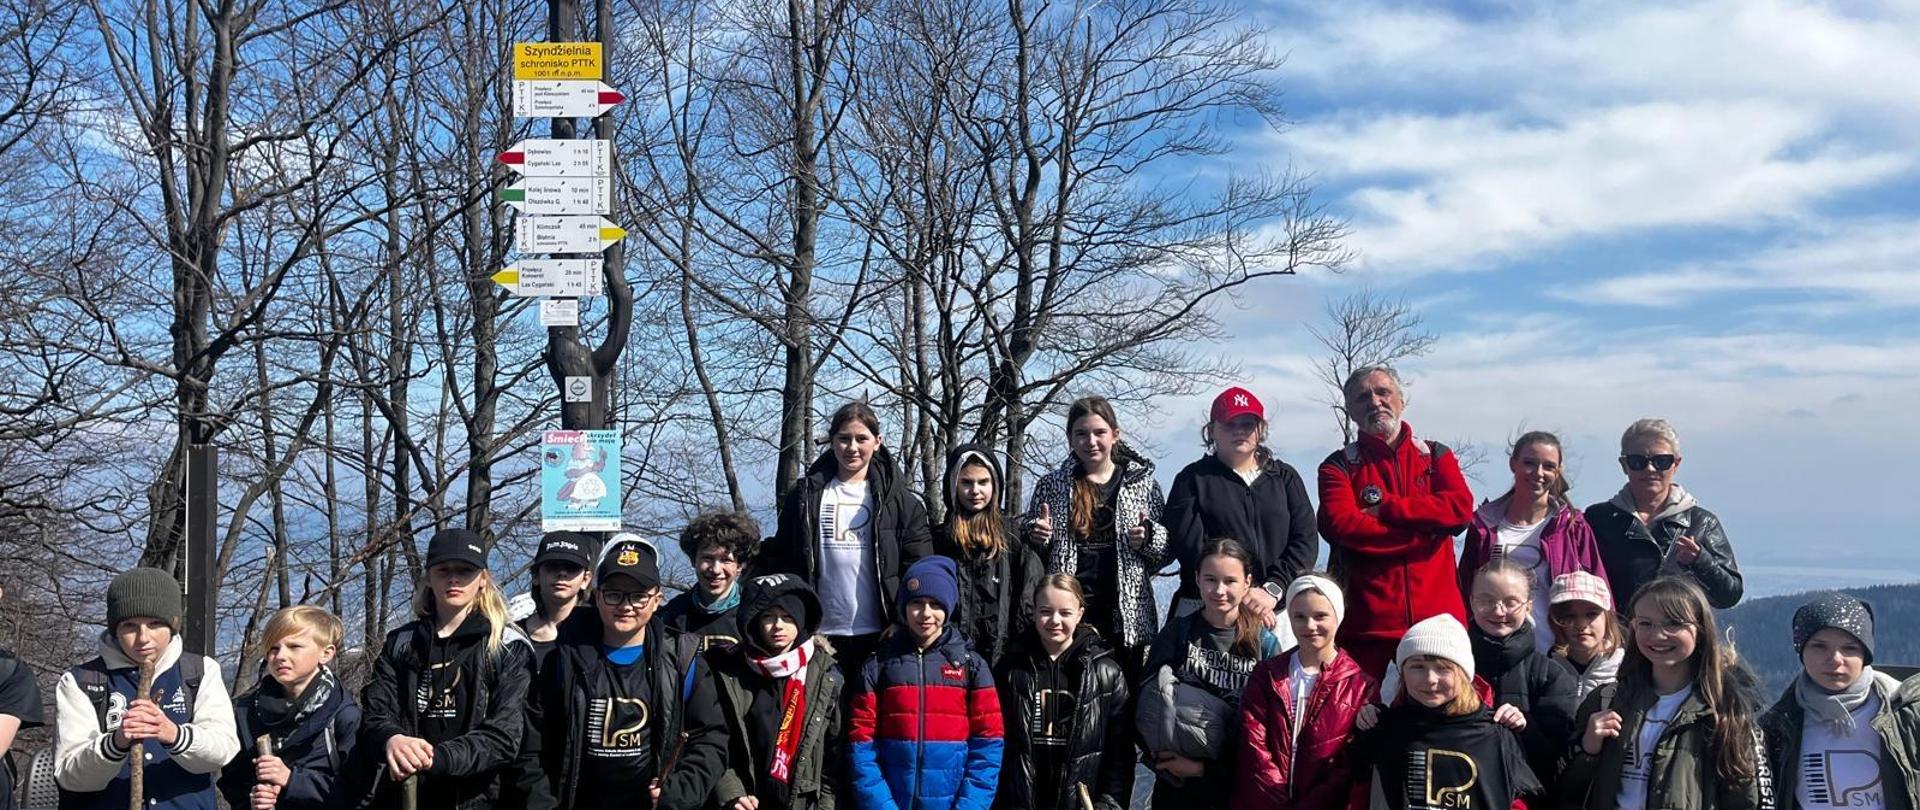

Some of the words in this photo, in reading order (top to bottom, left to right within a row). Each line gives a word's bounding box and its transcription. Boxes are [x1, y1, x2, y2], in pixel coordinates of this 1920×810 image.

[524, 45, 592, 58] Szyndzielnia
[520, 60, 569, 68] schronisko
[571, 59, 595, 67] PTTK
